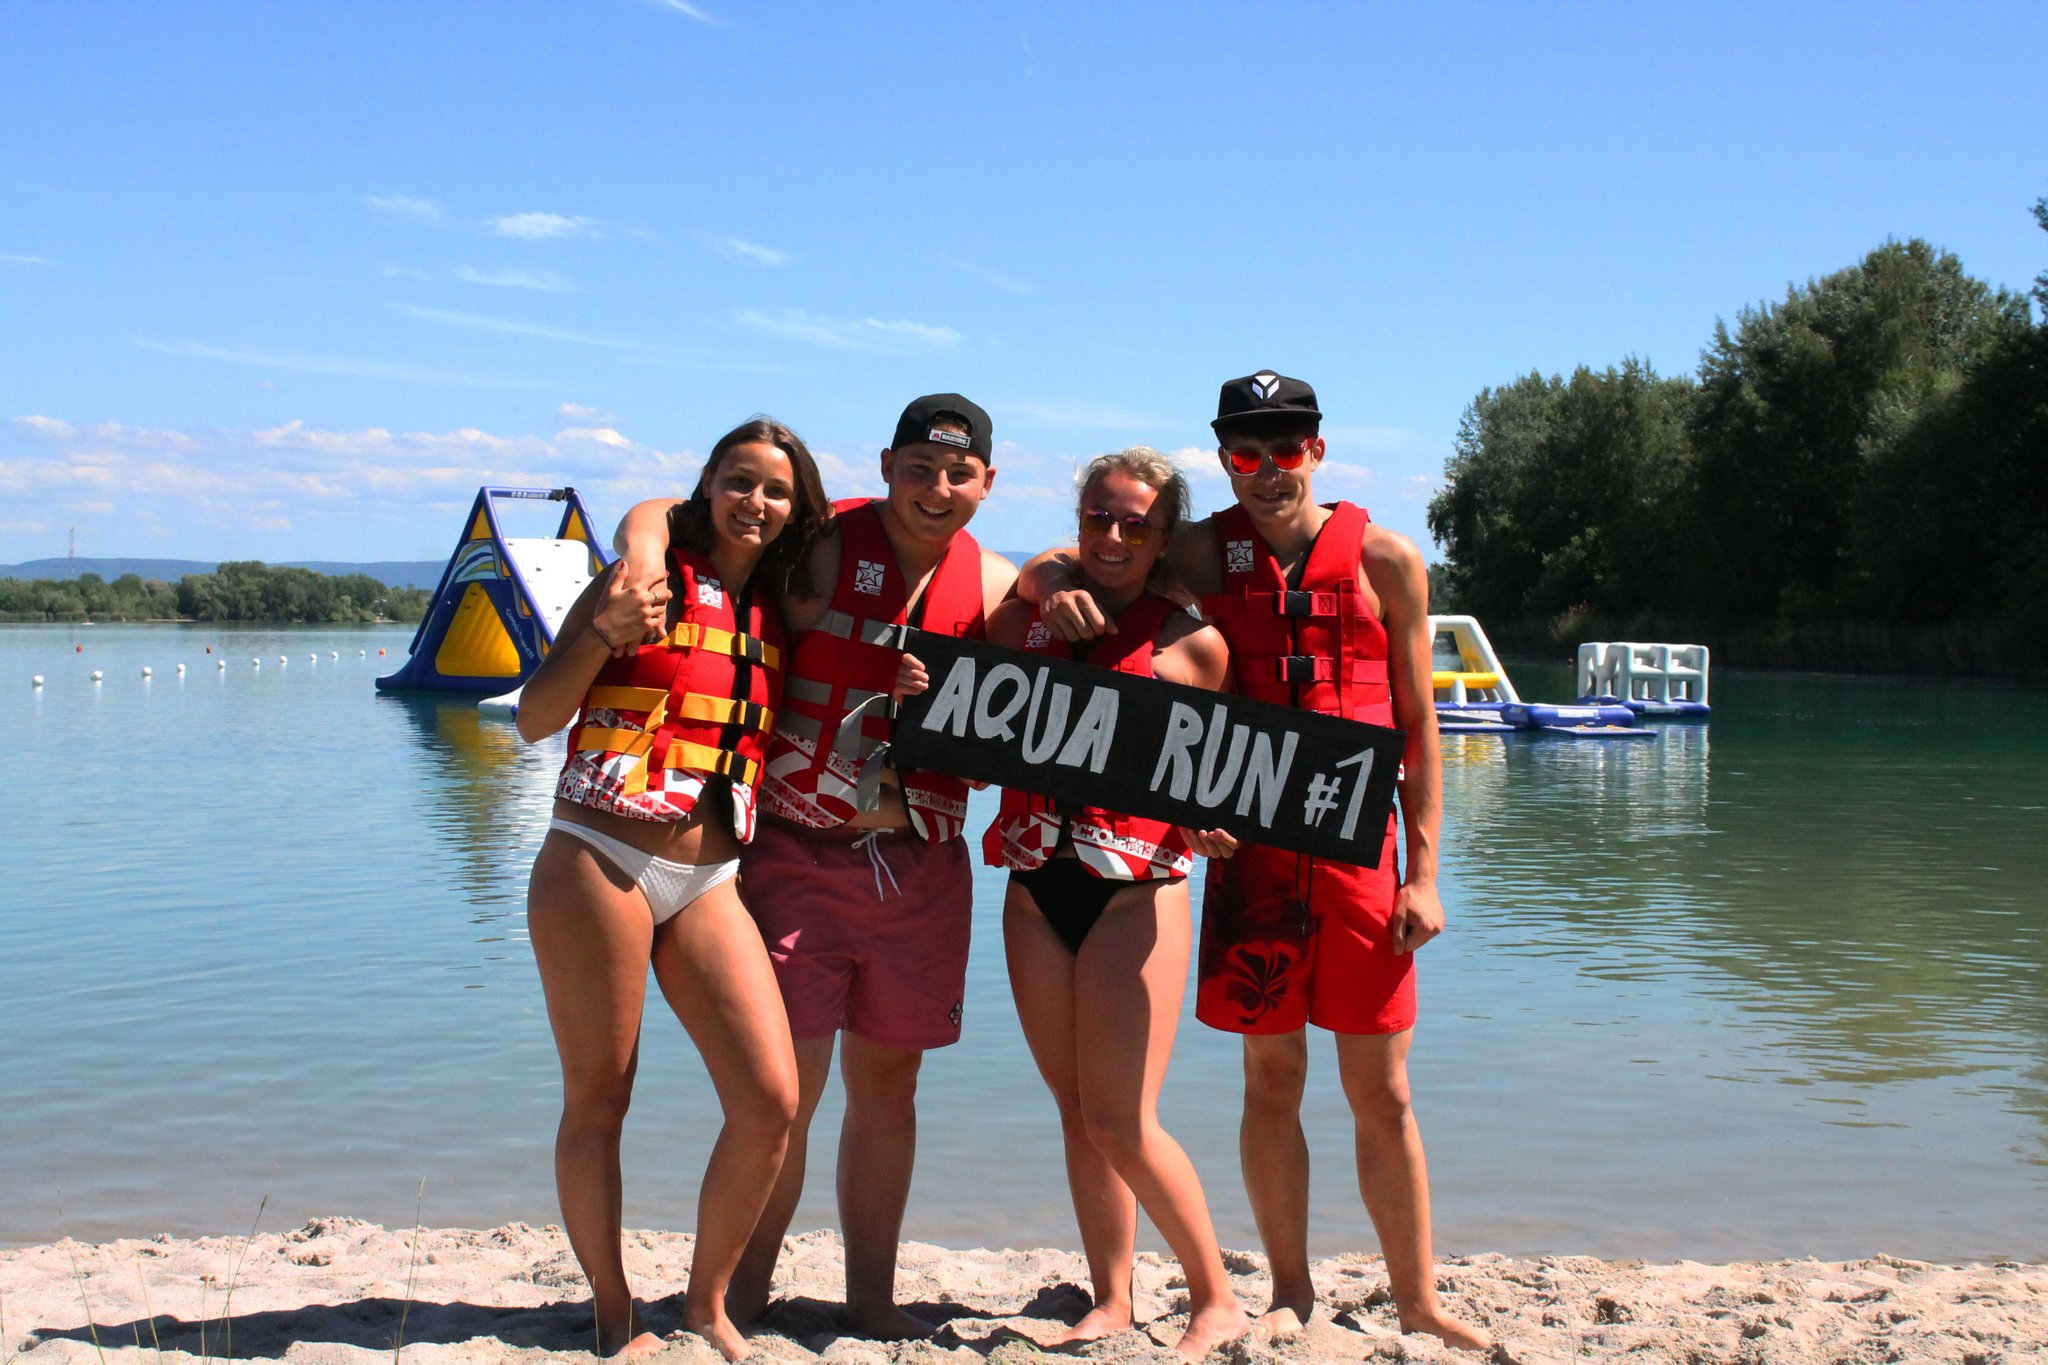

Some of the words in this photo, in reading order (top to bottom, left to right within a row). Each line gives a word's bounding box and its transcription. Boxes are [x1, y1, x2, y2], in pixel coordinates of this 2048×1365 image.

[921, 656, 1120, 773] AQUA
[1150, 701, 1300, 828] RUN
[1303, 747, 1375, 840] #1
